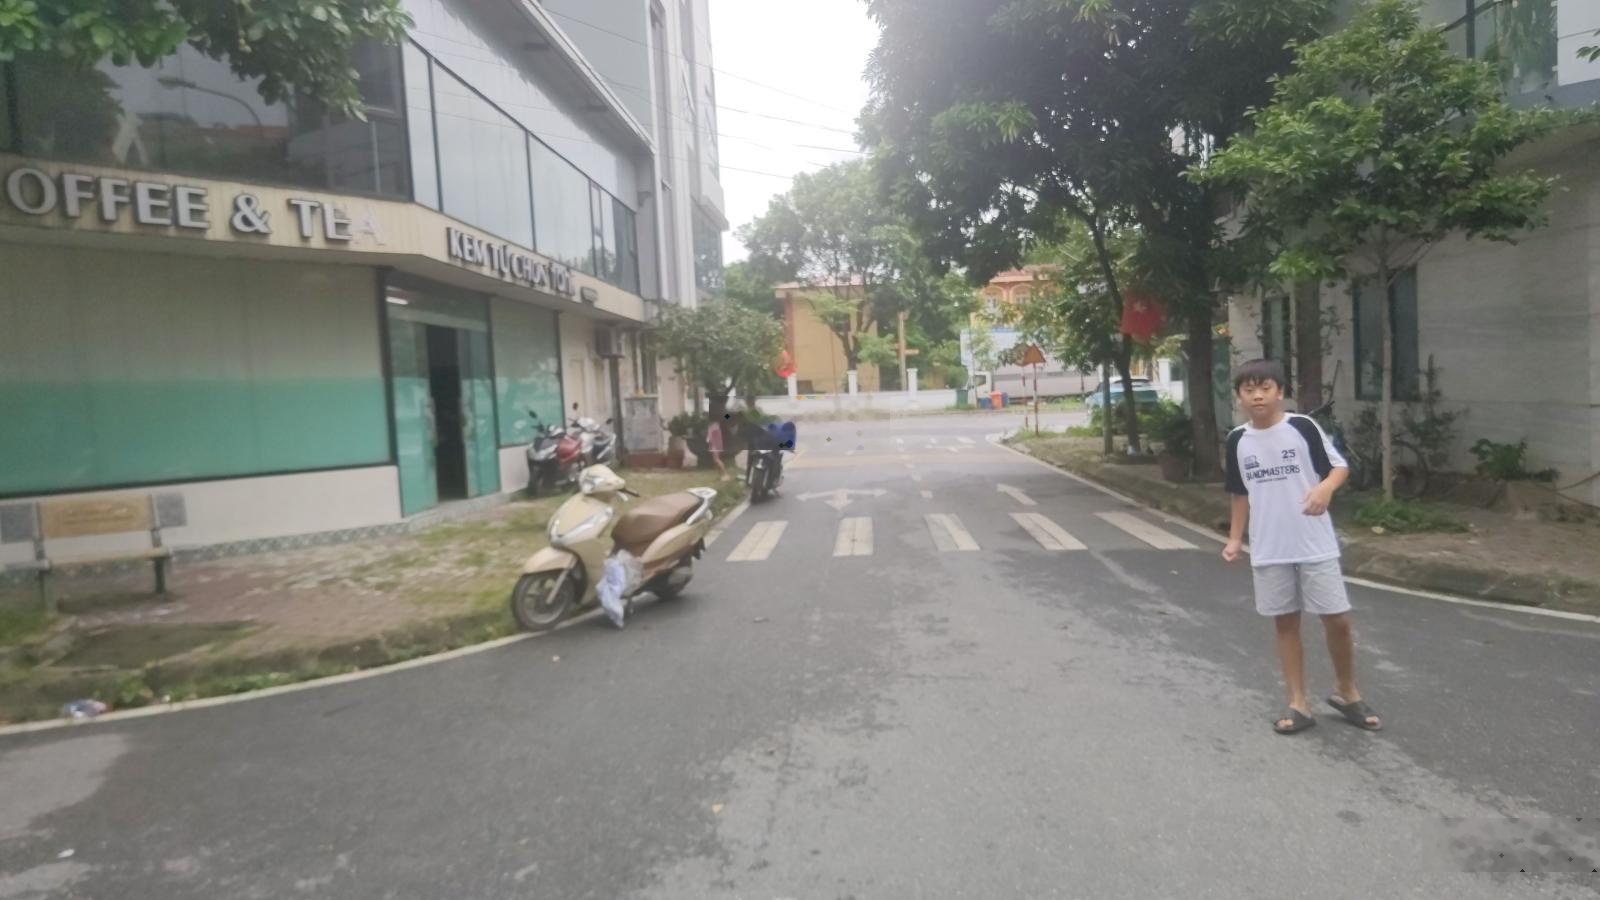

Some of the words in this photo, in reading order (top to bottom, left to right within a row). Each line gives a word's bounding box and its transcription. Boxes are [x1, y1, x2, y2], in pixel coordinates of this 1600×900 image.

[231, 193, 272, 235] &
[289, 198, 385, 247] TEA
[446, 226, 489, 266] KEM
[1281, 448, 1296, 460] 25
